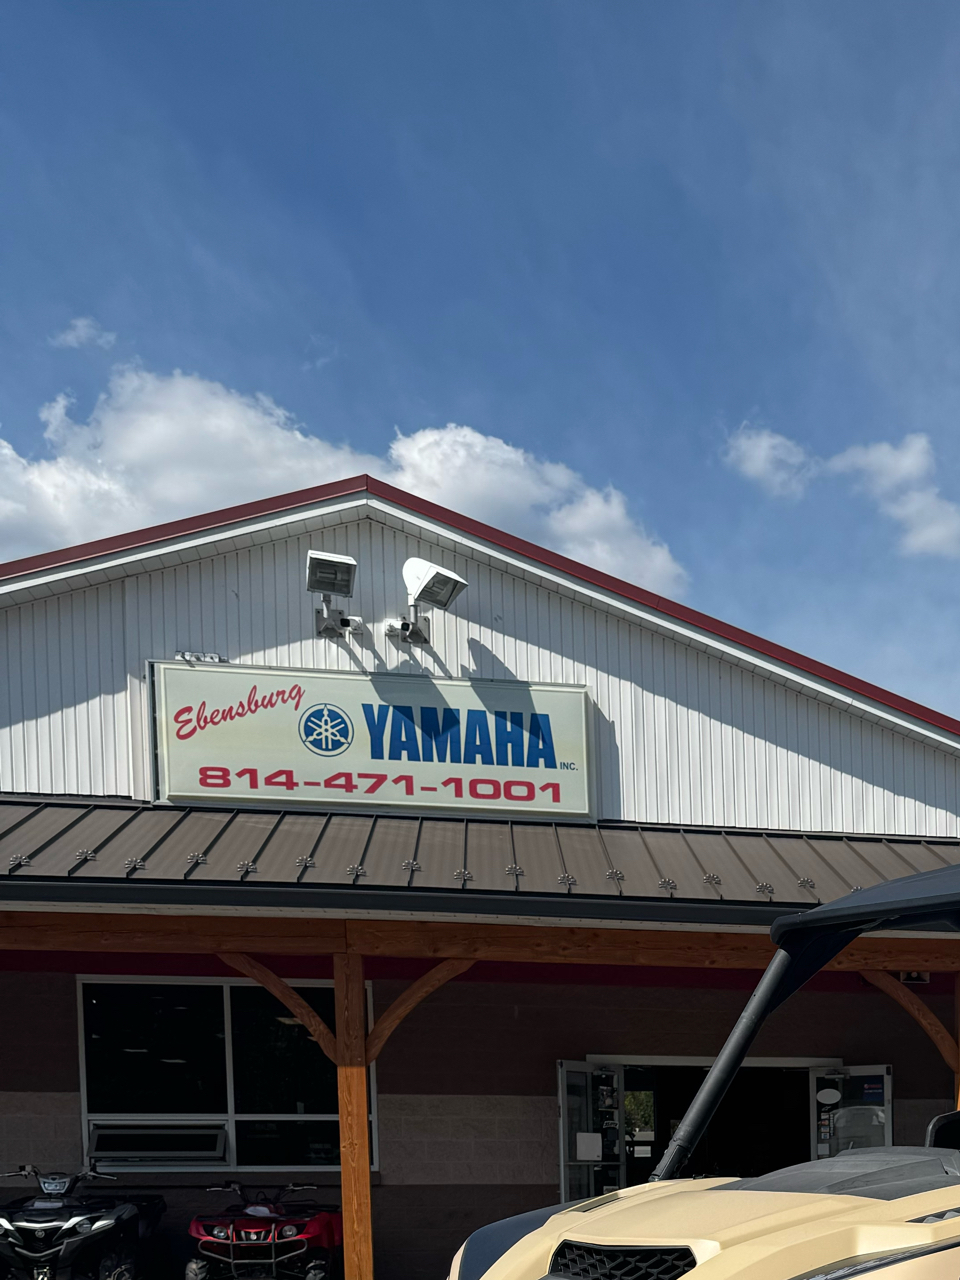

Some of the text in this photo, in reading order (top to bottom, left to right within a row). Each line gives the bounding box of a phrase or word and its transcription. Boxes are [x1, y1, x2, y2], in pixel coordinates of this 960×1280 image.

[173, 683, 306, 741] Ebensburg
[361, 703, 579, 772] YAMAHA INC.
[198, 766, 561, 804] 814-471-1001
